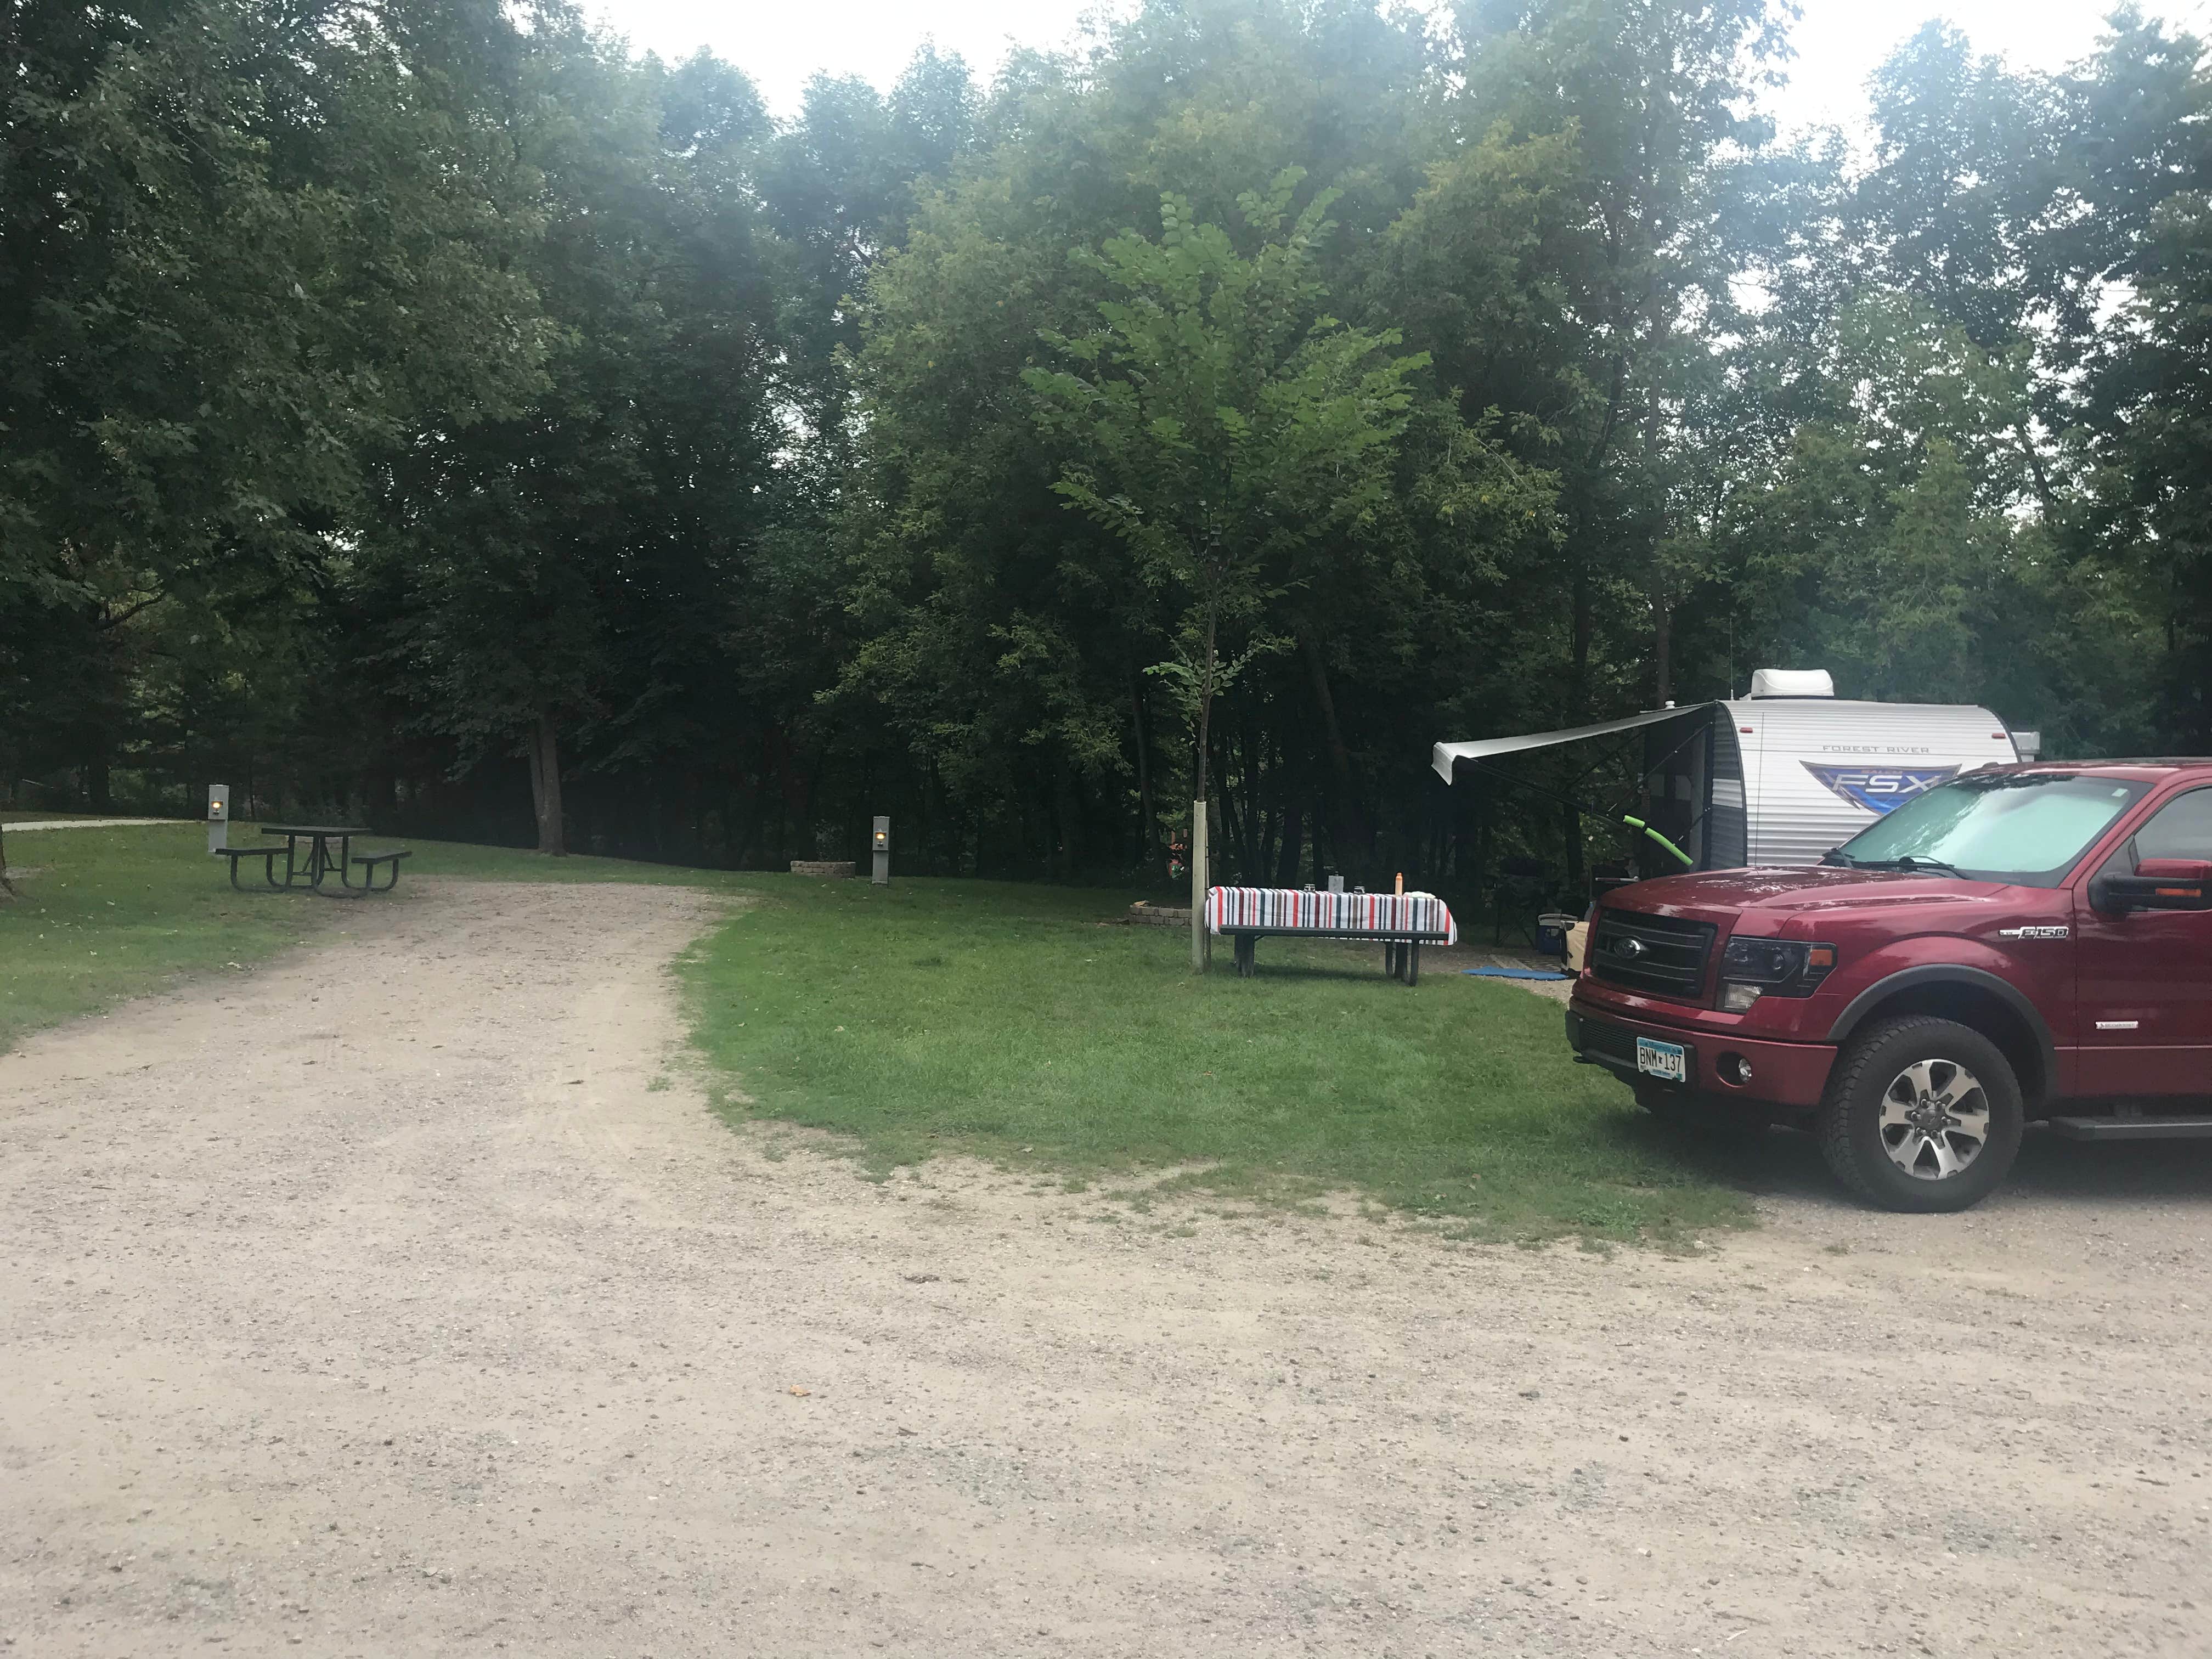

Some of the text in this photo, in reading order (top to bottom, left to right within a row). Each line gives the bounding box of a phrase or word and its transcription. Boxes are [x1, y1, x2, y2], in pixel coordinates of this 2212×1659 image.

[1832, 774, 1942, 793] FSX
[1640, 1047, 1657, 1068] BNM
[1664, 1052, 1681, 1073] 137
